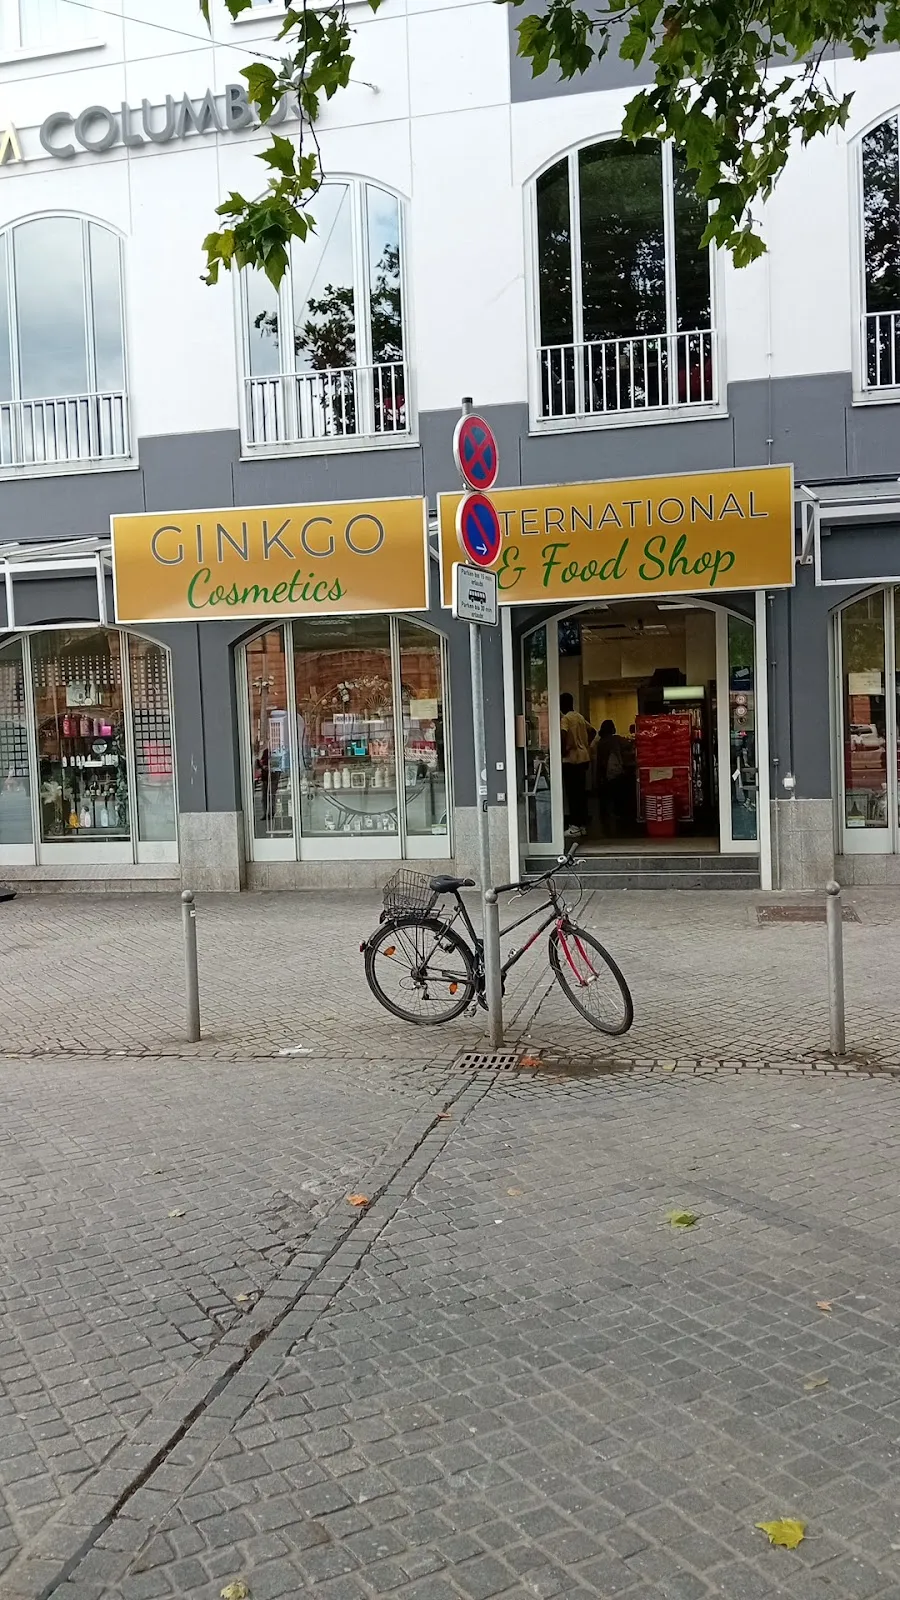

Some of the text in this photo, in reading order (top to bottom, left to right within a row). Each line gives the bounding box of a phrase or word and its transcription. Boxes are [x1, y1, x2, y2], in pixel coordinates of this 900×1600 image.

[498, 491, 769, 537] TERNATIONAL
[150, 513, 385, 566] GINKGO
[497, 534, 737, 590] & Food Shop
[187, 568, 347, 609] Cosmetics
